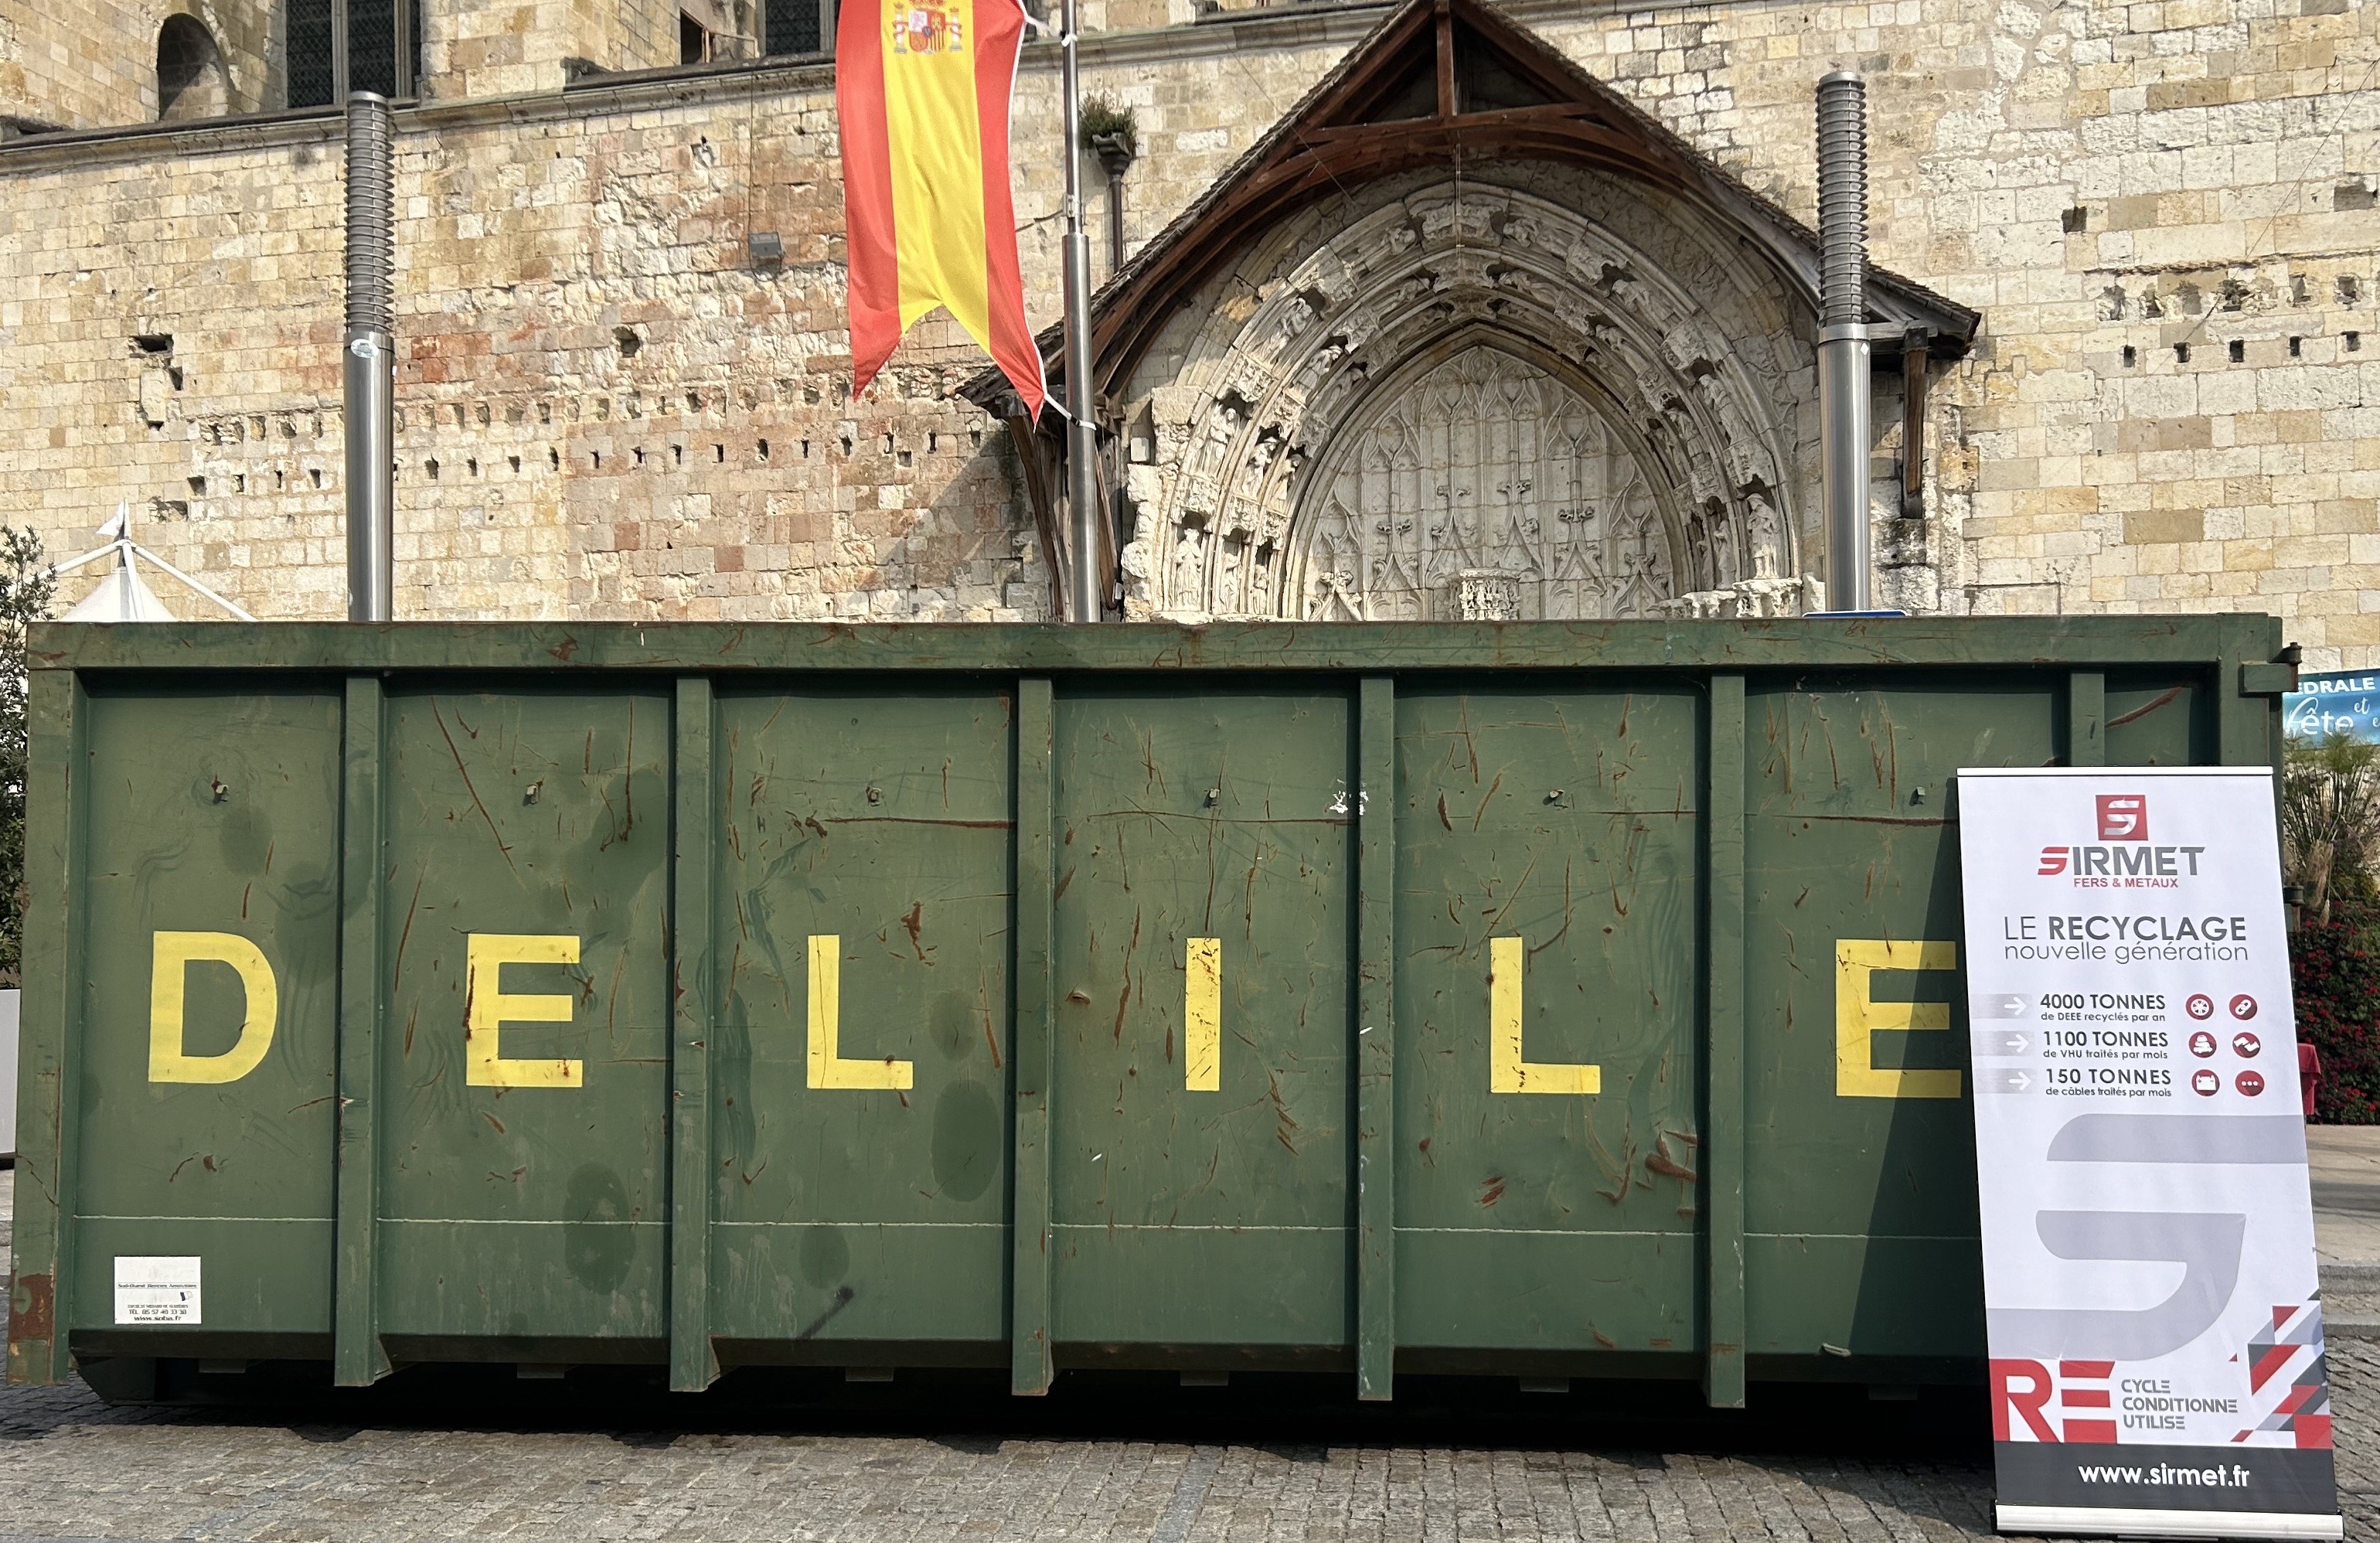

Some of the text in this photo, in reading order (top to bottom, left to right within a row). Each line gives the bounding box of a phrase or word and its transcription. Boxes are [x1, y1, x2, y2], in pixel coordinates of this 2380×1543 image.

[2037, 846, 2205, 876] SIRMET
[2073, 877, 2179, 888] FERS & METAUX
[2004, 915, 2246, 942] LE RECYCLAGE
[2004, 941, 2249, 965] nouvelle génération
[2040, 994, 2166, 1010] 4000 TONNES
[2041, 1012, 2055, 1020] de
[2084, 1012, 2129, 1022] recyclés
[2131, 1014, 2149, 1023] par
[2043, 1031, 2168, 1047] 1100 TONNES
[2085, 1049, 2119, 1058] traités
[2143, 1051, 2168, 1059] mois
[2046, 1068, 2171, 1085] 150 TONNES
[2045, 1087, 2172, 1098] de câbles traités par mois
[2121, 1379, 2170, 1394] CYCLE
[1989, 1358, 2118, 1445] RE
[2122, 1397, 2238, 1413] CONDITIONNE
[2123, 1415, 2185, 1430] UTILISE
[2079, 1462, 2250, 1487] www.sirmet.fr
